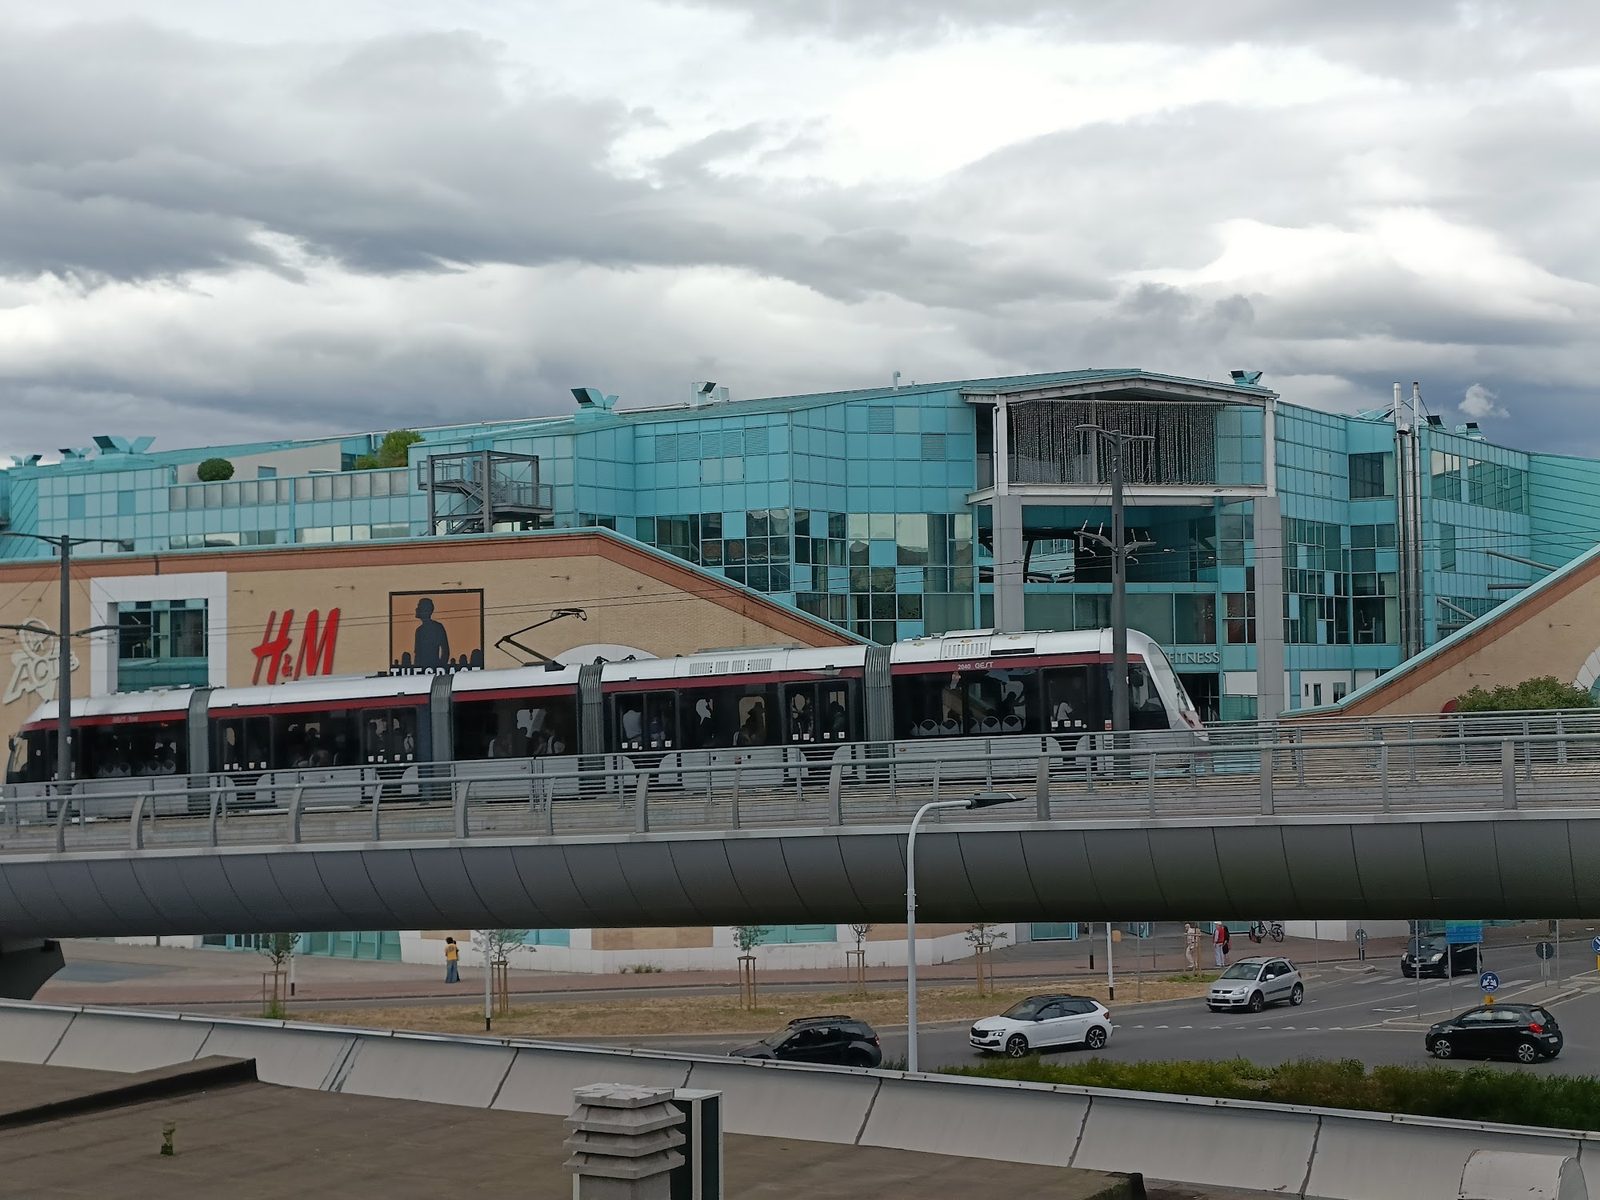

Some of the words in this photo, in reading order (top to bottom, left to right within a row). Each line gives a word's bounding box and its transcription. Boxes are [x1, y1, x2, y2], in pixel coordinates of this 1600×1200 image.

[251, 608, 341, 686] H&M
[1168, 651, 1220, 664] FITNESS
[974, 661, 994, 669] GEST
